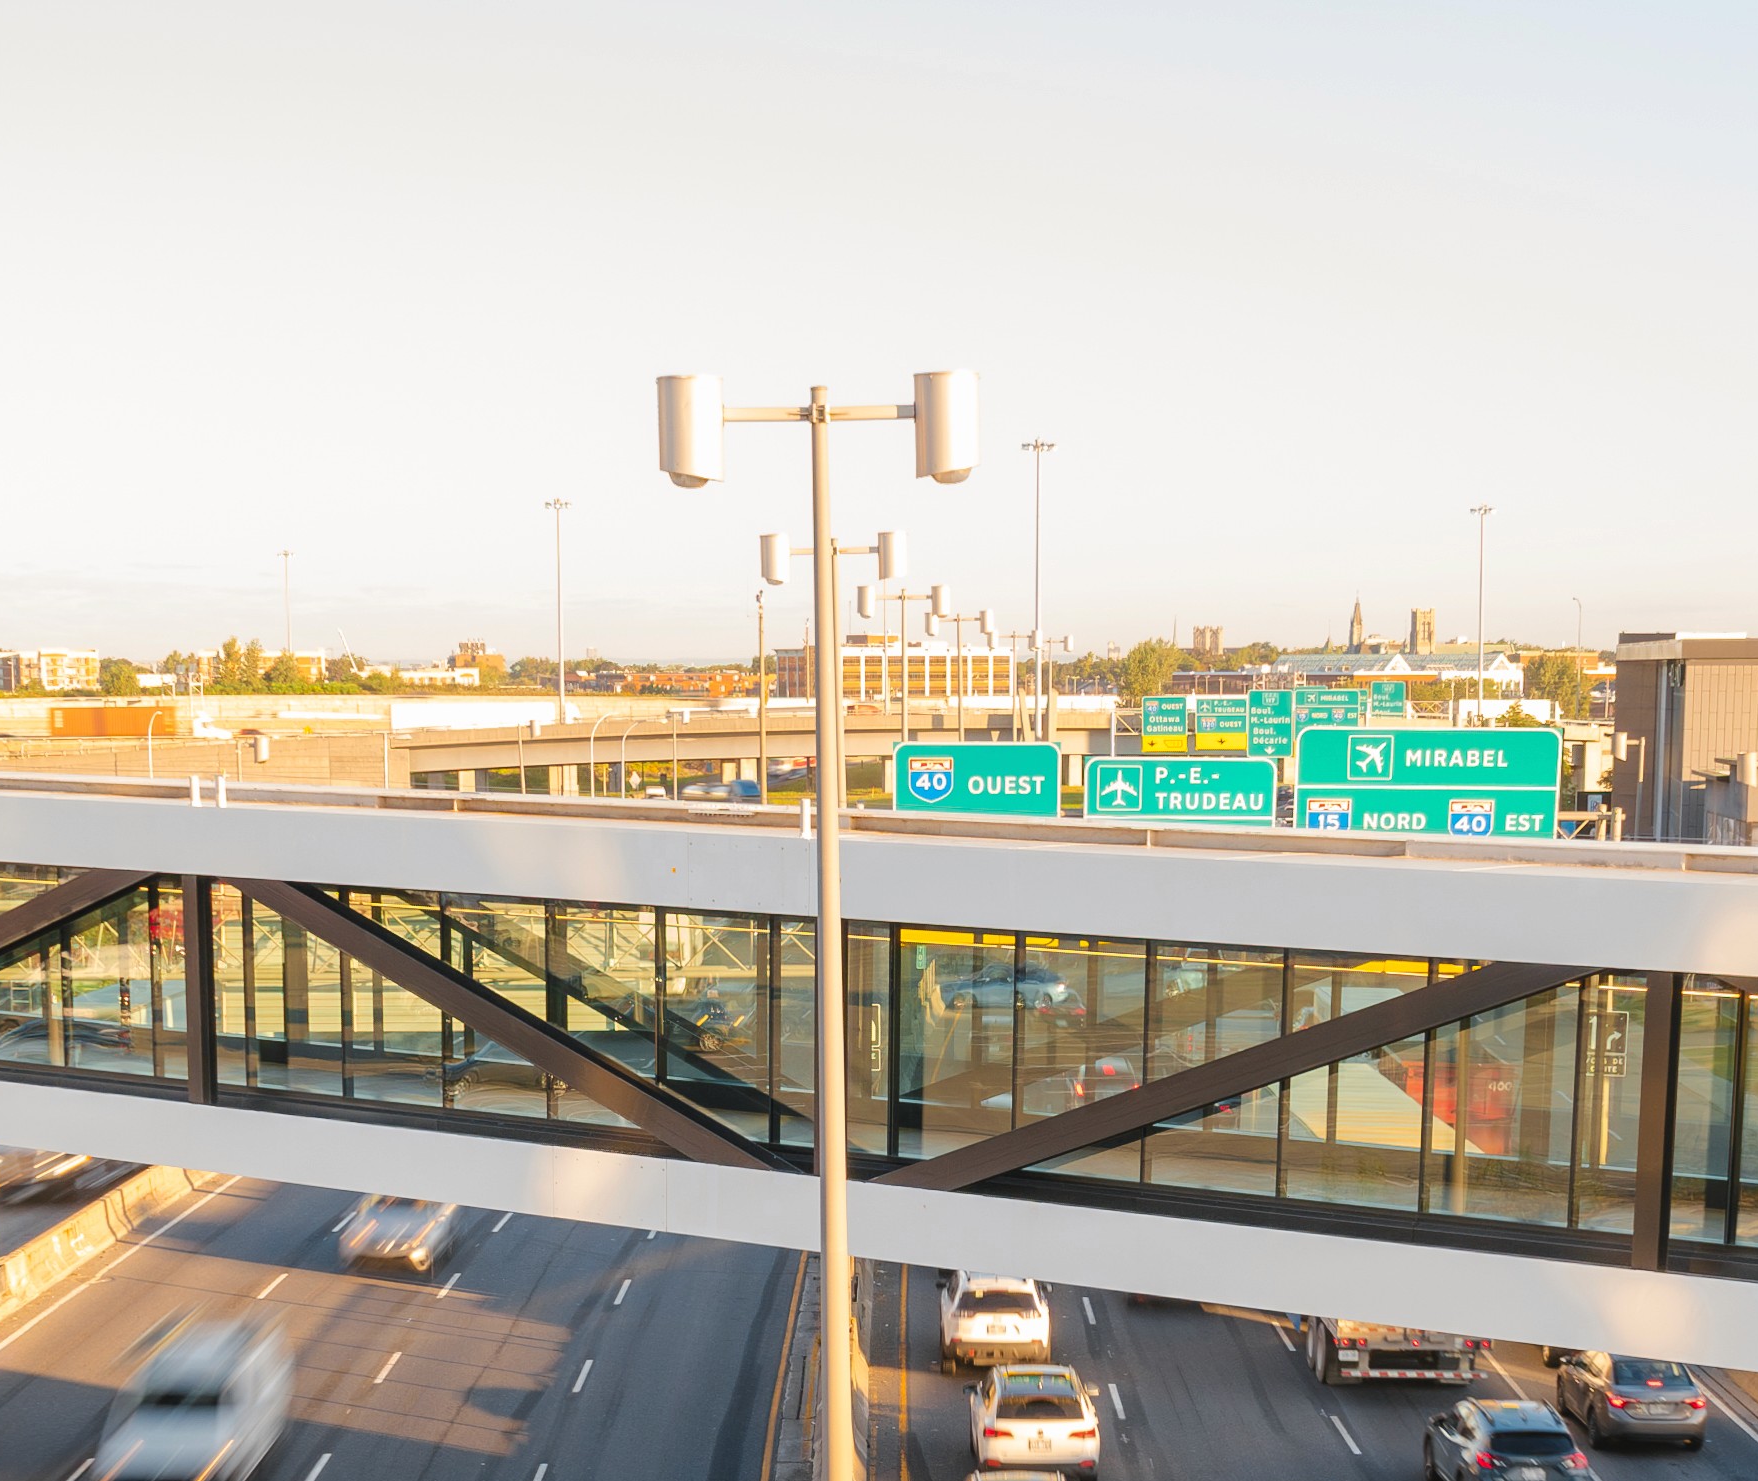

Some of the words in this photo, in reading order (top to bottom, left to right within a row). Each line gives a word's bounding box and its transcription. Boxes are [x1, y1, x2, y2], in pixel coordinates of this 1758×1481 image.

[1251, 707, 1274, 715] Boul.
[1146, 724, 1183, 732] Gatineau
[1251, 716, 1290, 724] M.-Laurin
[1253, 736, 1288, 745] Décarie
[1405, 749, 1508, 768] MIRABEL
[915, 772, 947, 791] 40
[968, 775, 1046, 795] OUEST
[1154, 767, 1221, 784] P.-E.-
[1155, 791, 1264, 811] TRUDEAU
[1317, 814, 1340, 830] 15
[1362, 813, 1426, 830] NORD
[1454, 815, 1486, 833] 40
[1505, 814, 1544, 832] EST
